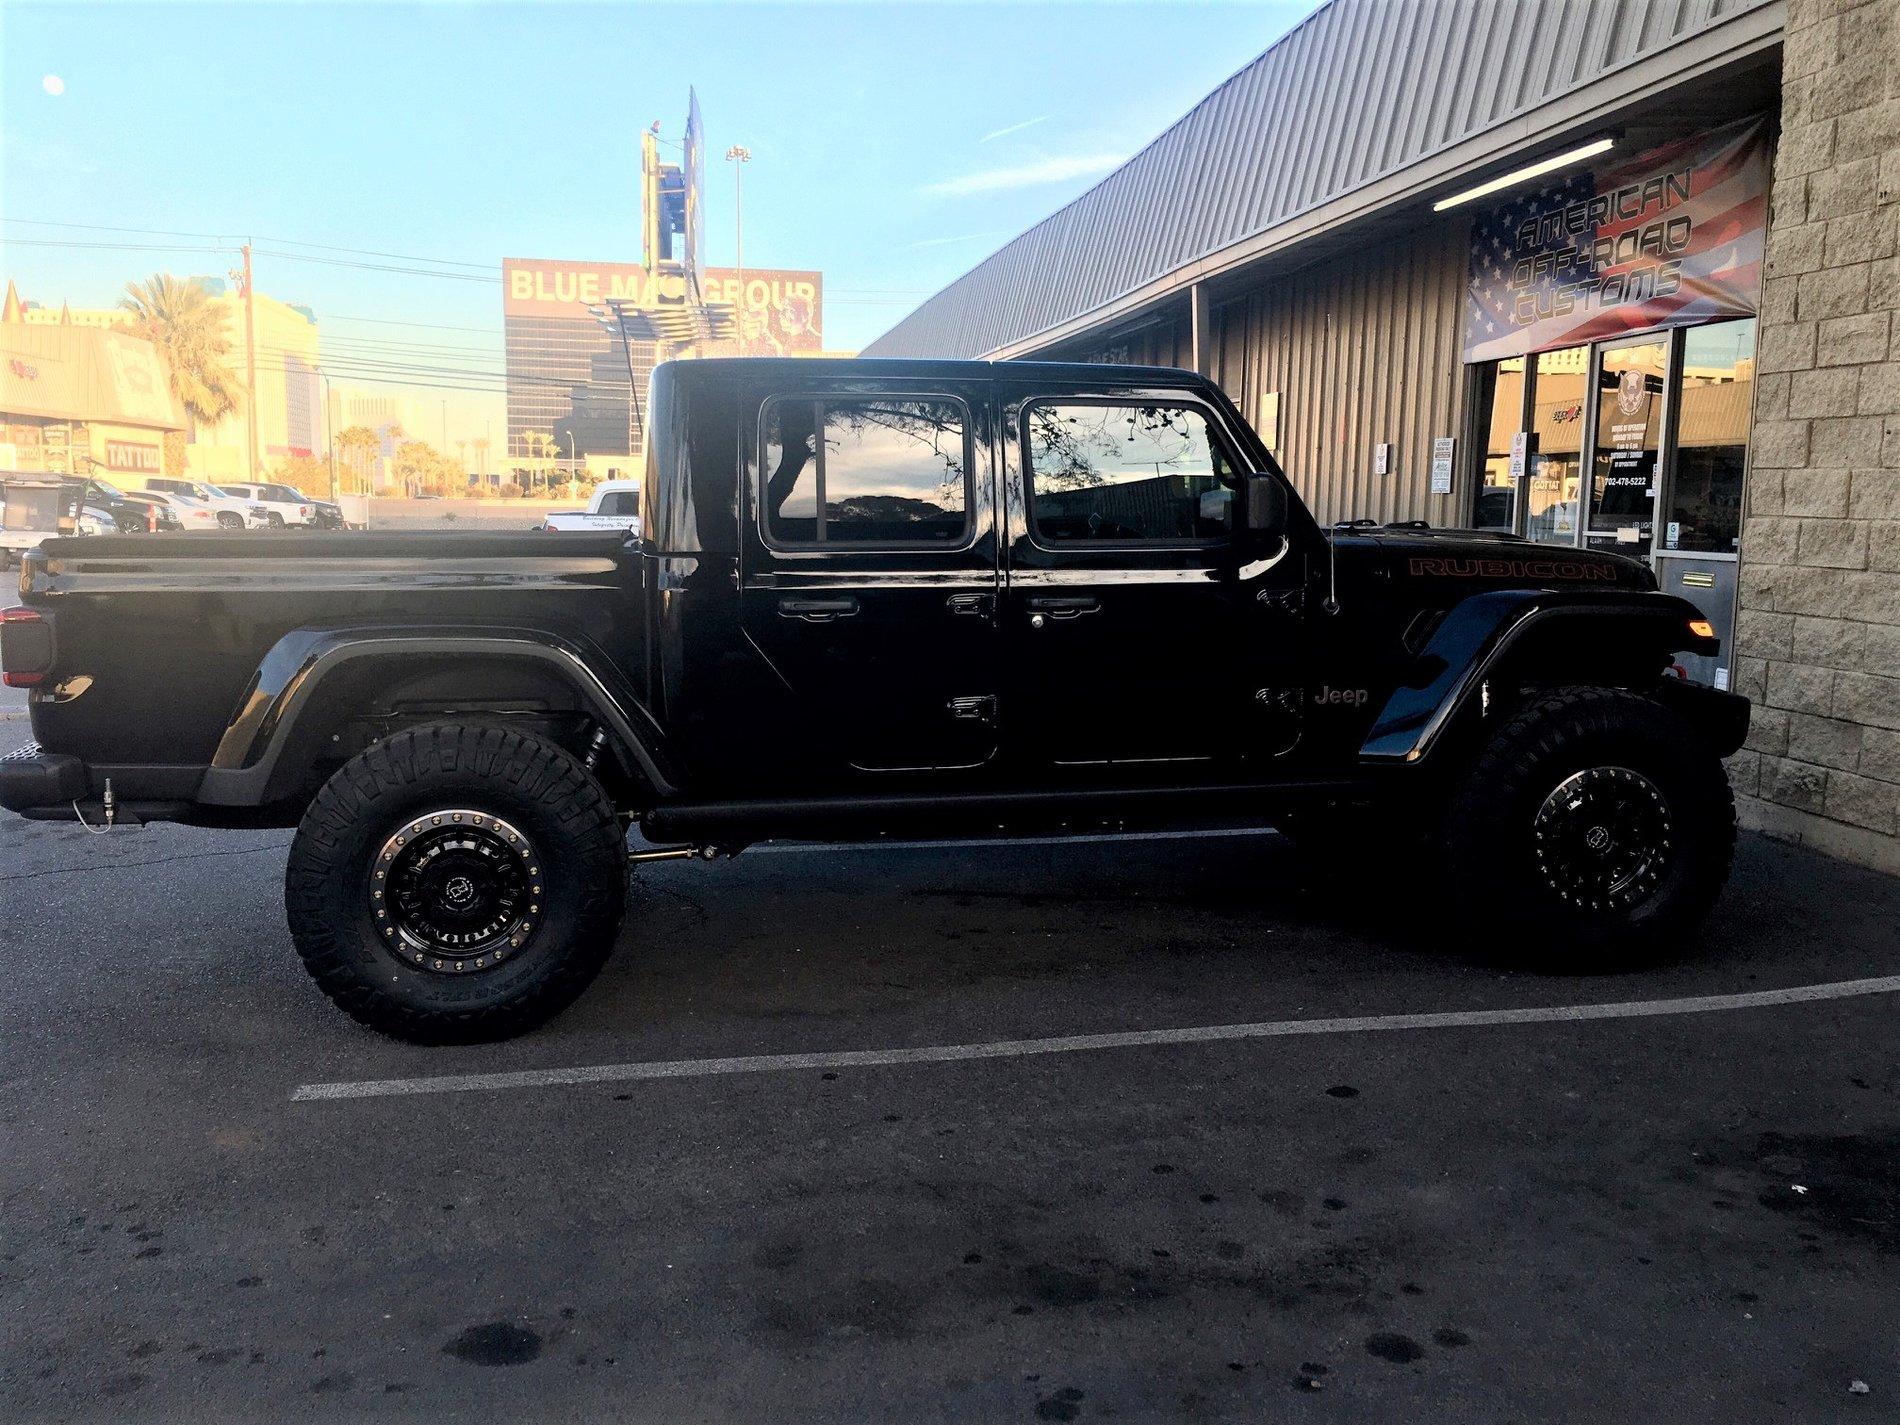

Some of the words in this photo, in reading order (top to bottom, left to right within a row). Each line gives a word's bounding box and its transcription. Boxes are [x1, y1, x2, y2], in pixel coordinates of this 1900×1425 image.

[1515, 167, 1692, 252] AMERICAN
[1512, 214, 1692, 291] OFF-ROAD
[510, 269, 602, 303] BLUE
[704, 276, 816, 312] GROUP
[1514, 259, 1683, 326] CUSTOMS
[107, 444, 159, 468] TATTOO
[1604, 476, 1647, 486] 702-478-5222
[1409, 557, 1617, 581] RUBICON
[1314, 685, 1368, 708] Jeep
